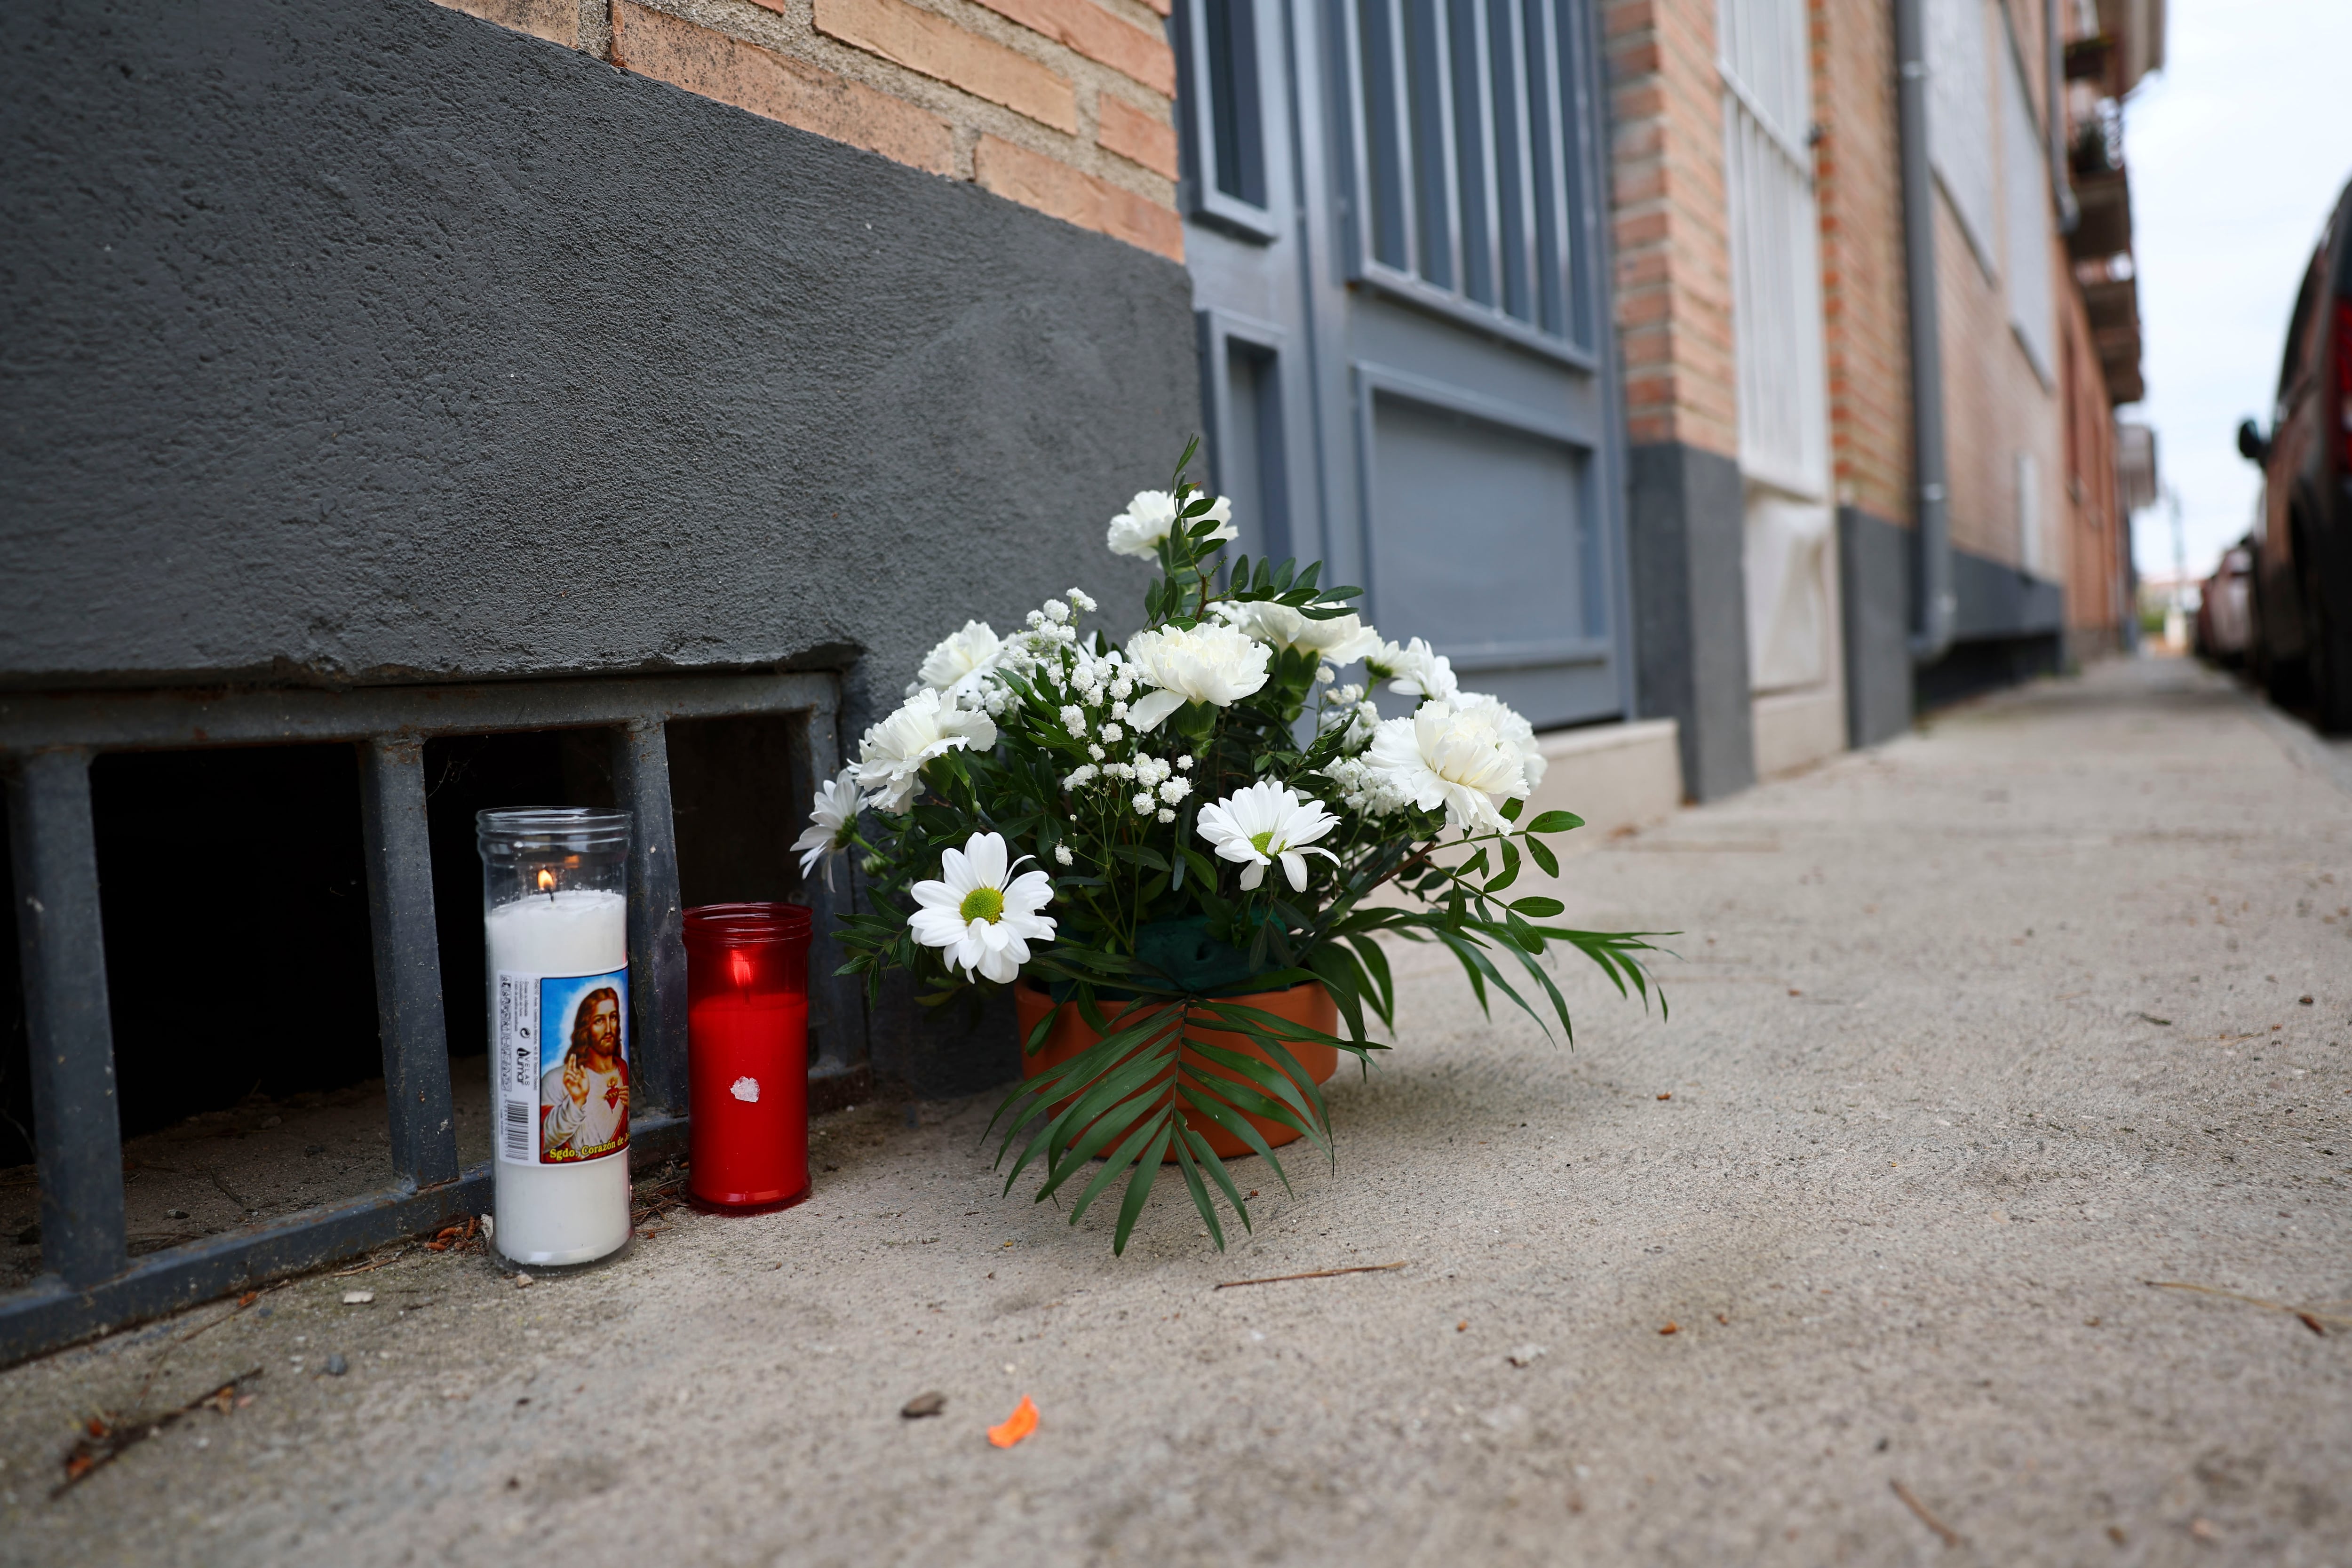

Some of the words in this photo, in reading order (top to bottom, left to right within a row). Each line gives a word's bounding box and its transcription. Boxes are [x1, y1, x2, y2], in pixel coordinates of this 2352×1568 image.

[549, 1148, 579, 1161] Sgdo.
[581, 1140, 616, 1155] Corazón
[617, 1136, 624, 1146] de
